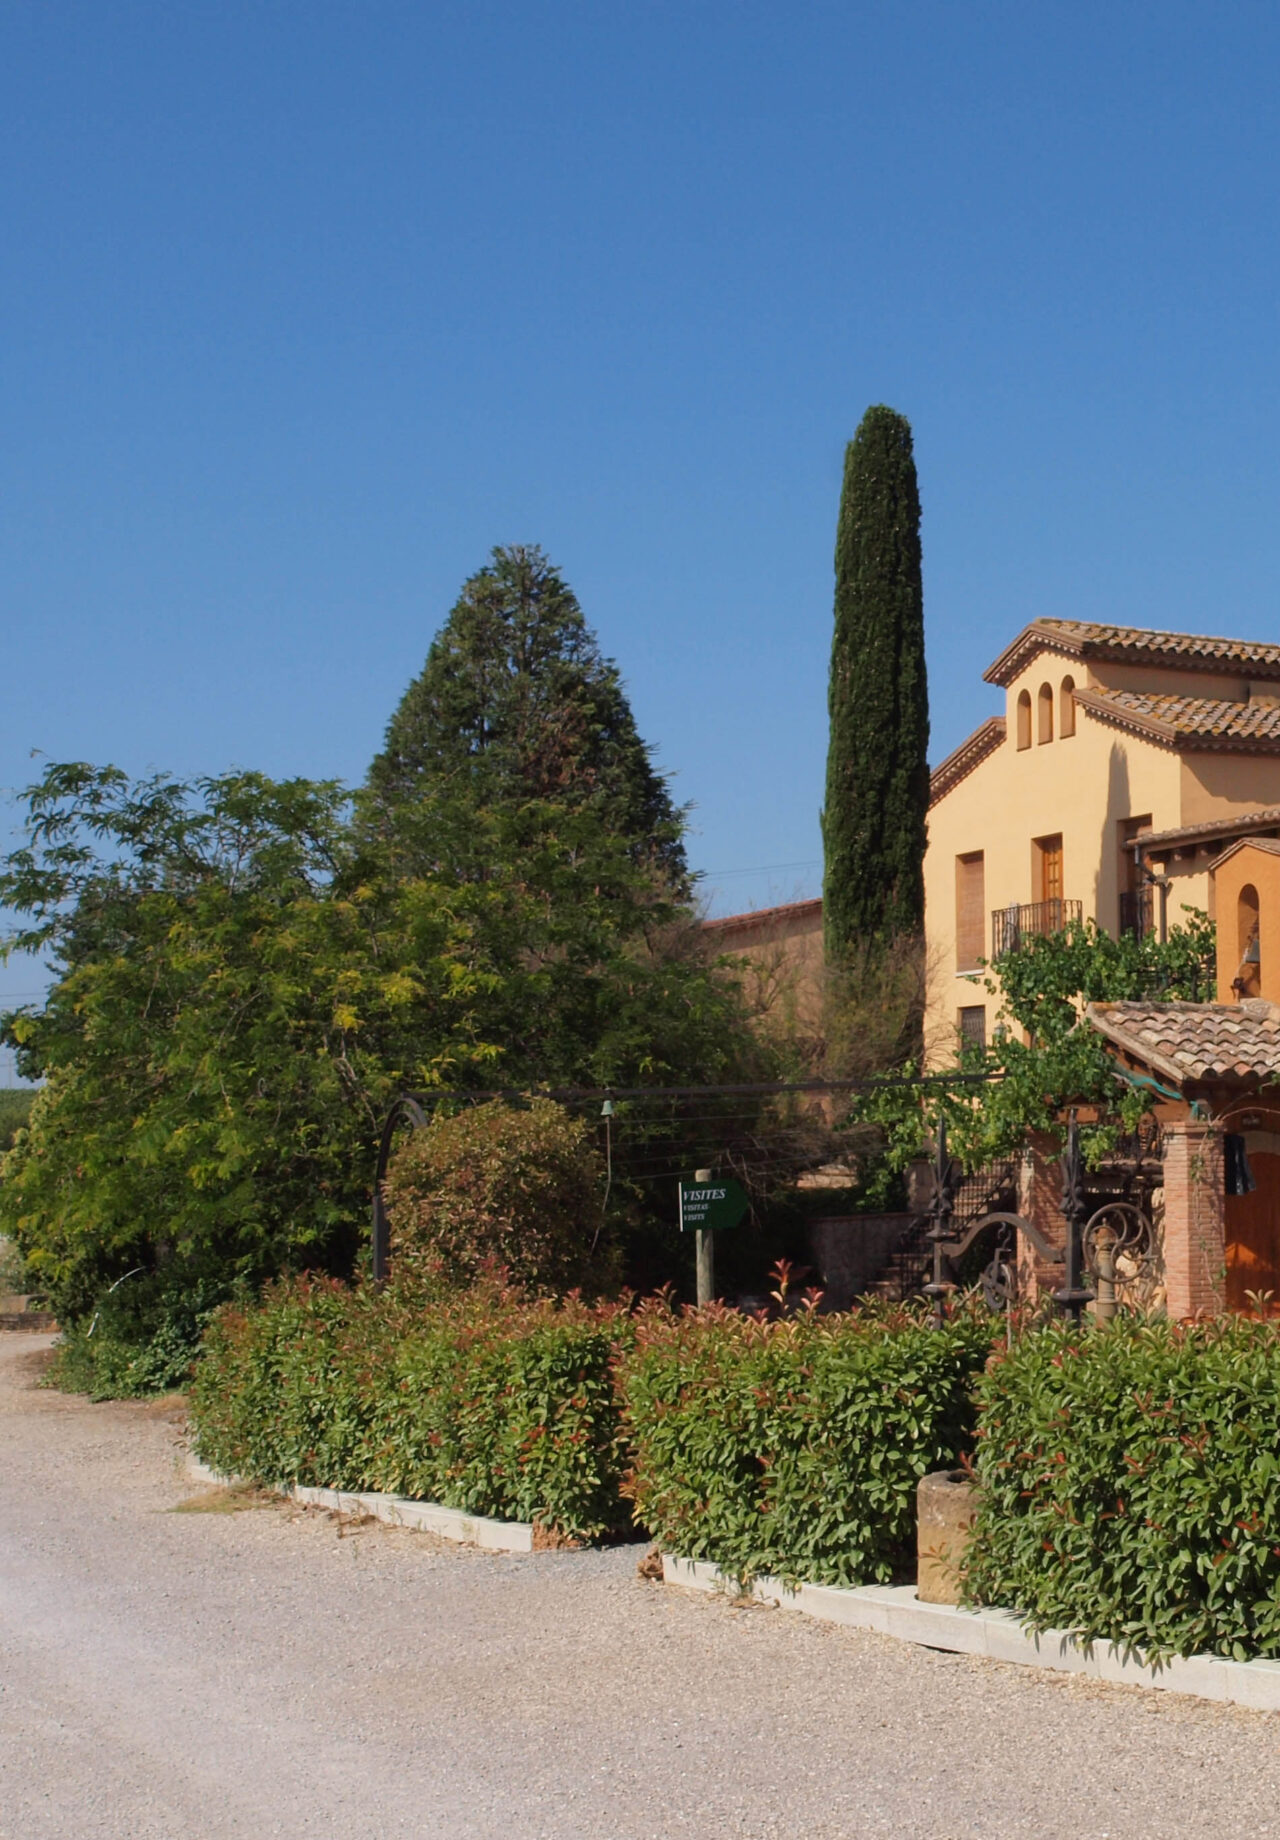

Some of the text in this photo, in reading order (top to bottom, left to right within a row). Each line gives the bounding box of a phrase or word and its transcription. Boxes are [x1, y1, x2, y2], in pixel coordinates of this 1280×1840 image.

[684, 1188, 726, 1200] VISITES
[684, 1203, 709, 1211] VISITAS
[684, 1213, 705, 1221] VISITS
